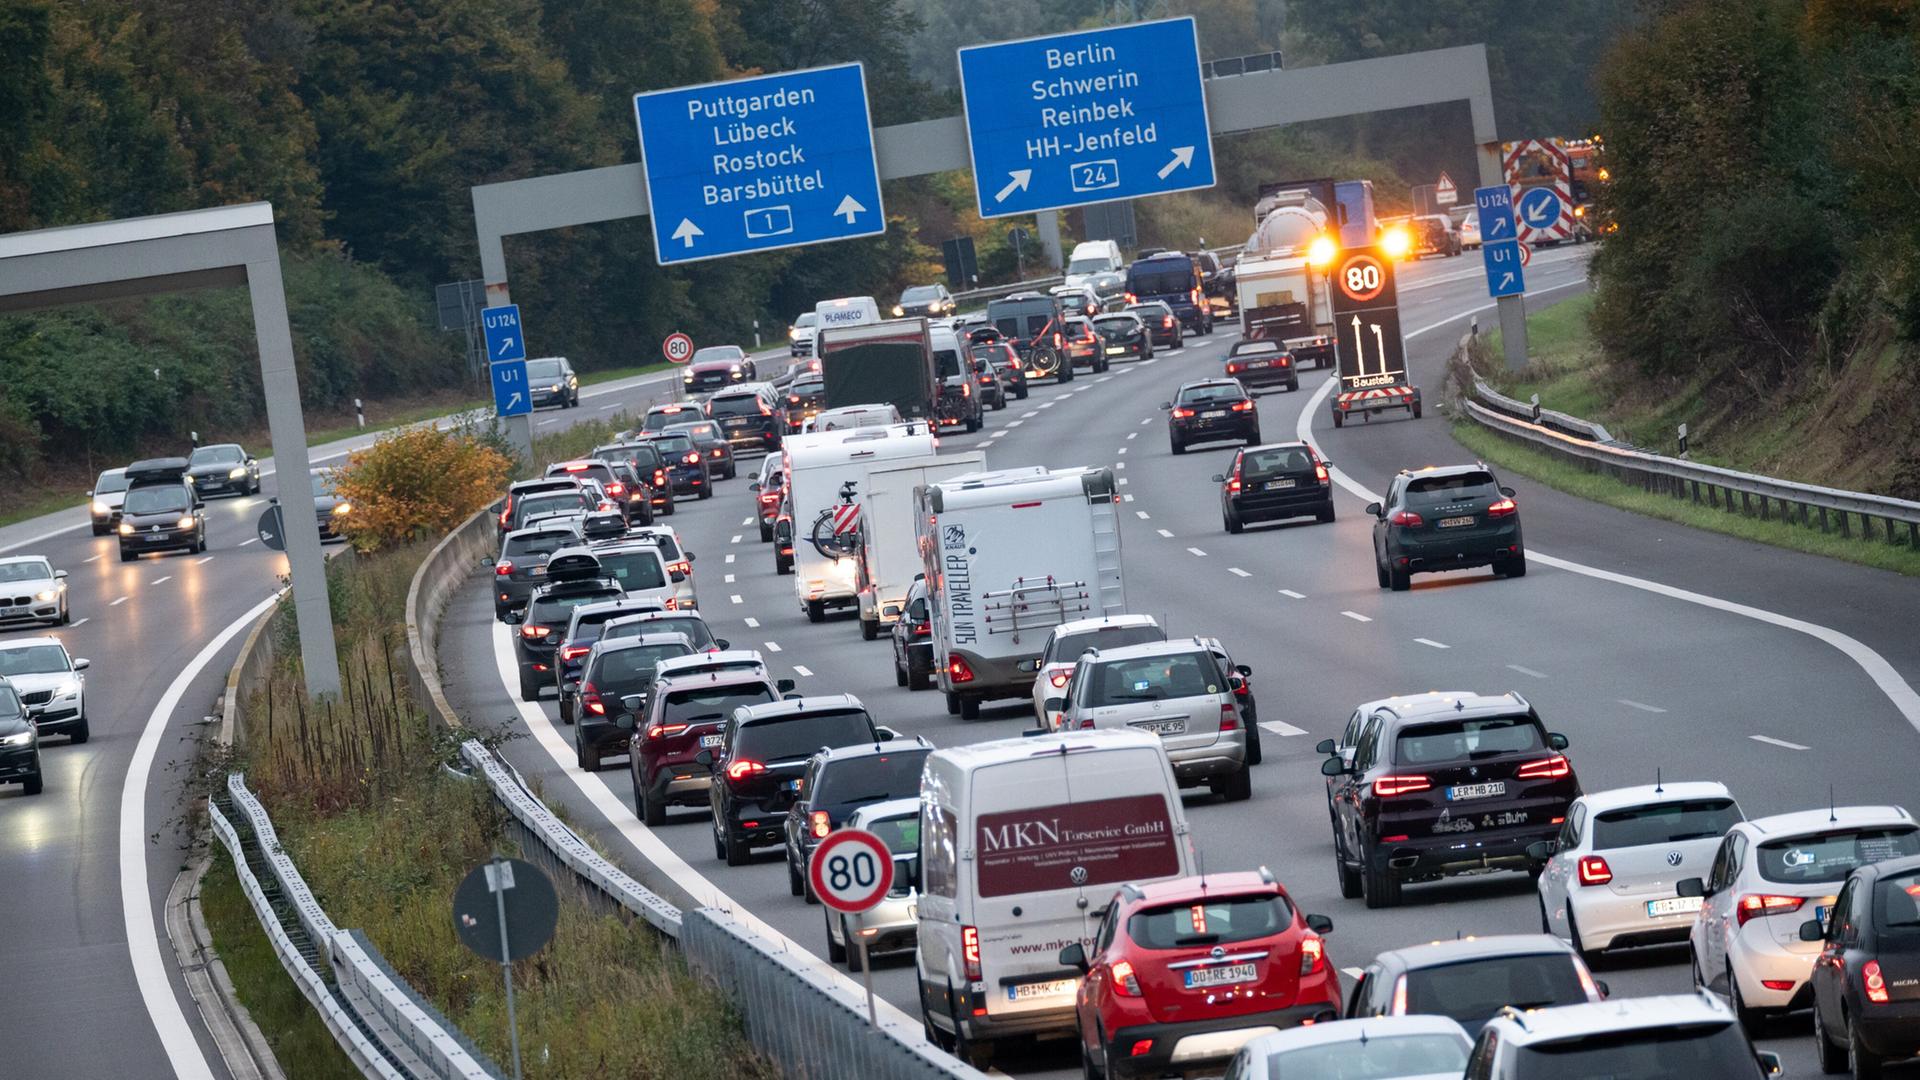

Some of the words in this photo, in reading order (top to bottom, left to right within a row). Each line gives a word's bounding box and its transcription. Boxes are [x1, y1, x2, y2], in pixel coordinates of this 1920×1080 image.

[1046, 43, 1116, 70] Berlin
[1031, 69, 1138, 100] Schwerin
[688, 88, 815, 120] Puttgarden
[1041, 98, 1135, 128] Reinbek
[714, 116, 796, 146] Lübeck
[1025, 122, 1158, 160] HH-Jenfeld
[713, 144, 806, 175] Rostock
[703, 170, 824, 206] Barsbüttel
[1083, 168, 1107, 185] 24
[765, 213, 772, 230] 1
[1346, 265, 1379, 292] 80
[824, 310, 862, 322] PLAMECO
[670, 342, 687, 354] 80
[1352, 374, 1394, 388] Baustelle
[946, 554, 974, 618] TRAVELLER
[954, 622, 977, 644] SUN
[1160, 723, 1172, 732] WE
[1173, 722, 1184, 730] 95
[1452, 787, 1469, 798] LER
[1475, 785, 1486, 794] HB
[1488, 784, 1504, 793] 210
[981, 818, 1060, 852] MKN
[1062, 826, 1122, 842] Torservice
[1124, 820, 1164, 836] GmbH
[828, 851, 876, 892] 80
[1214, 968, 1226, 980] RE
[1229, 965, 1254, 978] 1940
[1016, 984, 1030, 997] HB
